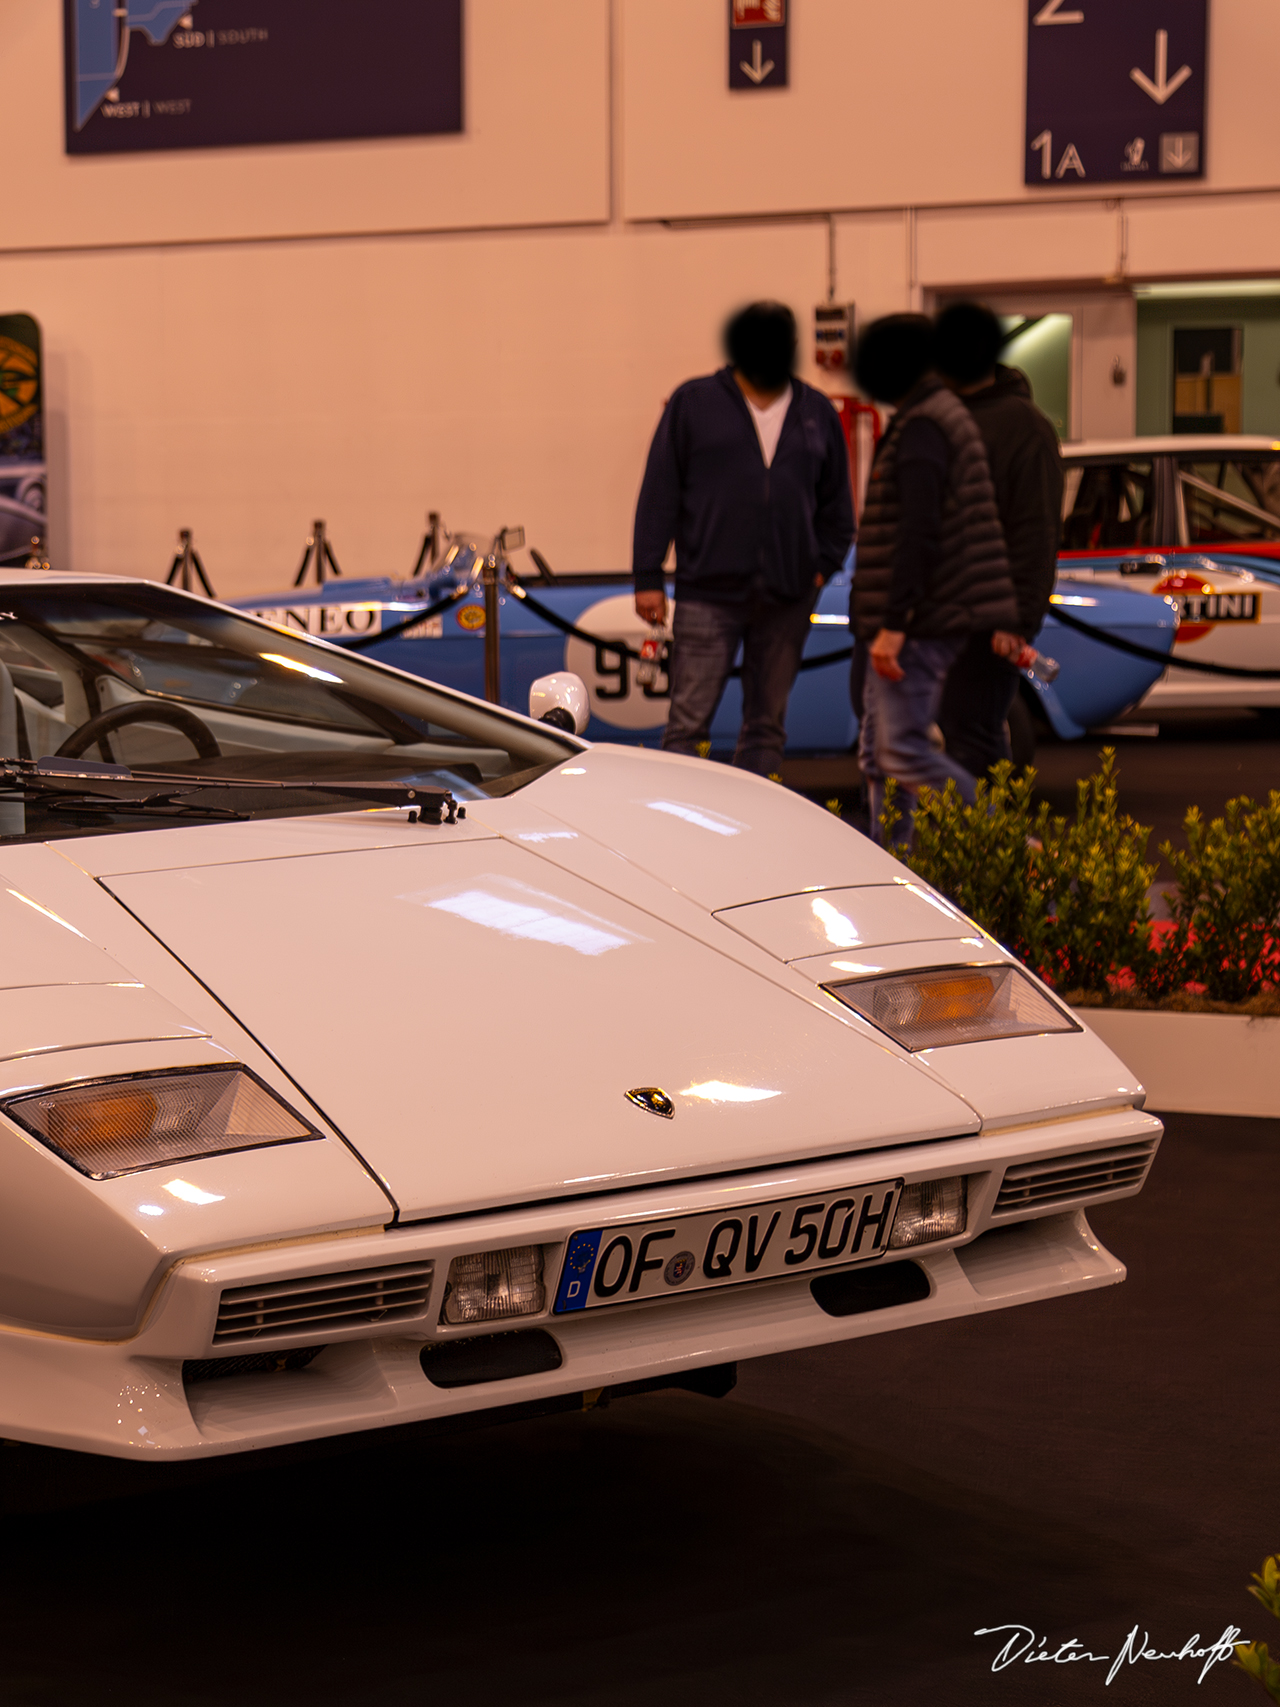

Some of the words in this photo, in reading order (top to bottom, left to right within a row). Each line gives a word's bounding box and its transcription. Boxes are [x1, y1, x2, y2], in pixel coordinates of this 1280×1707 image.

[218, 27, 269, 46] SOUTH
[101, 101, 141, 119] WEST
[1030, 128, 1087, 179] 1A
[1175, 594, 1255, 619] RTINI
[567, 1281, 581, 1298] D
[593, 1228, 677, 1298] OF
[702, 1210, 781, 1279] QV
[784, 1188, 895, 1266] 50H
